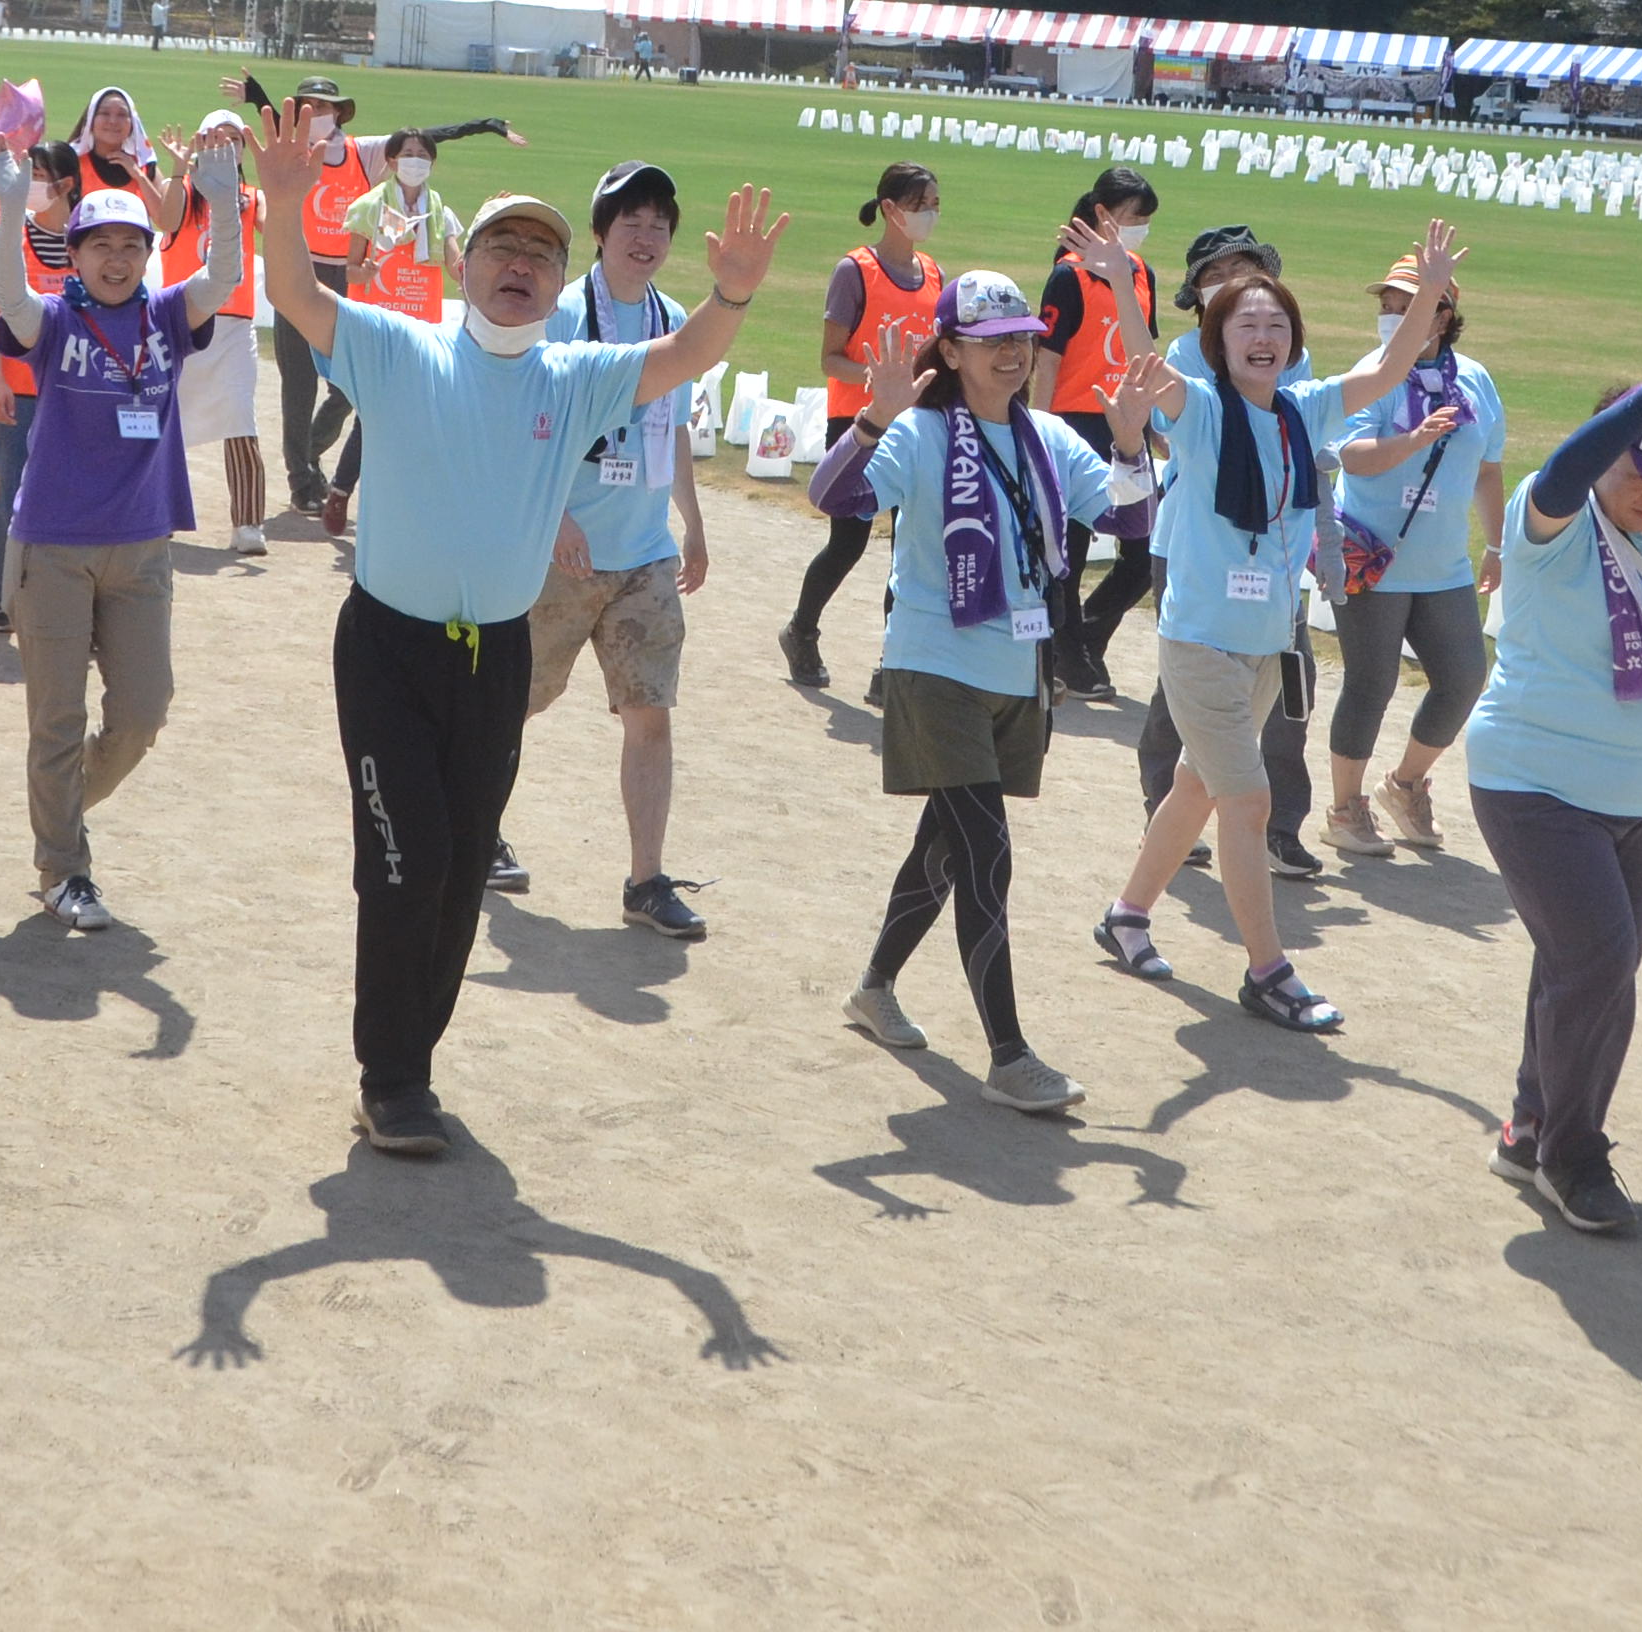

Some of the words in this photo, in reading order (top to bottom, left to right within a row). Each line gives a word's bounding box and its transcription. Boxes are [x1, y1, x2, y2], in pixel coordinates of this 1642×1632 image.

[956, 555, 966, 580] FOR
[966, 553, 976, 593] RELAY
[956, 581, 966, 608] LIFE
[361, 755, 402, 885] HEAD
